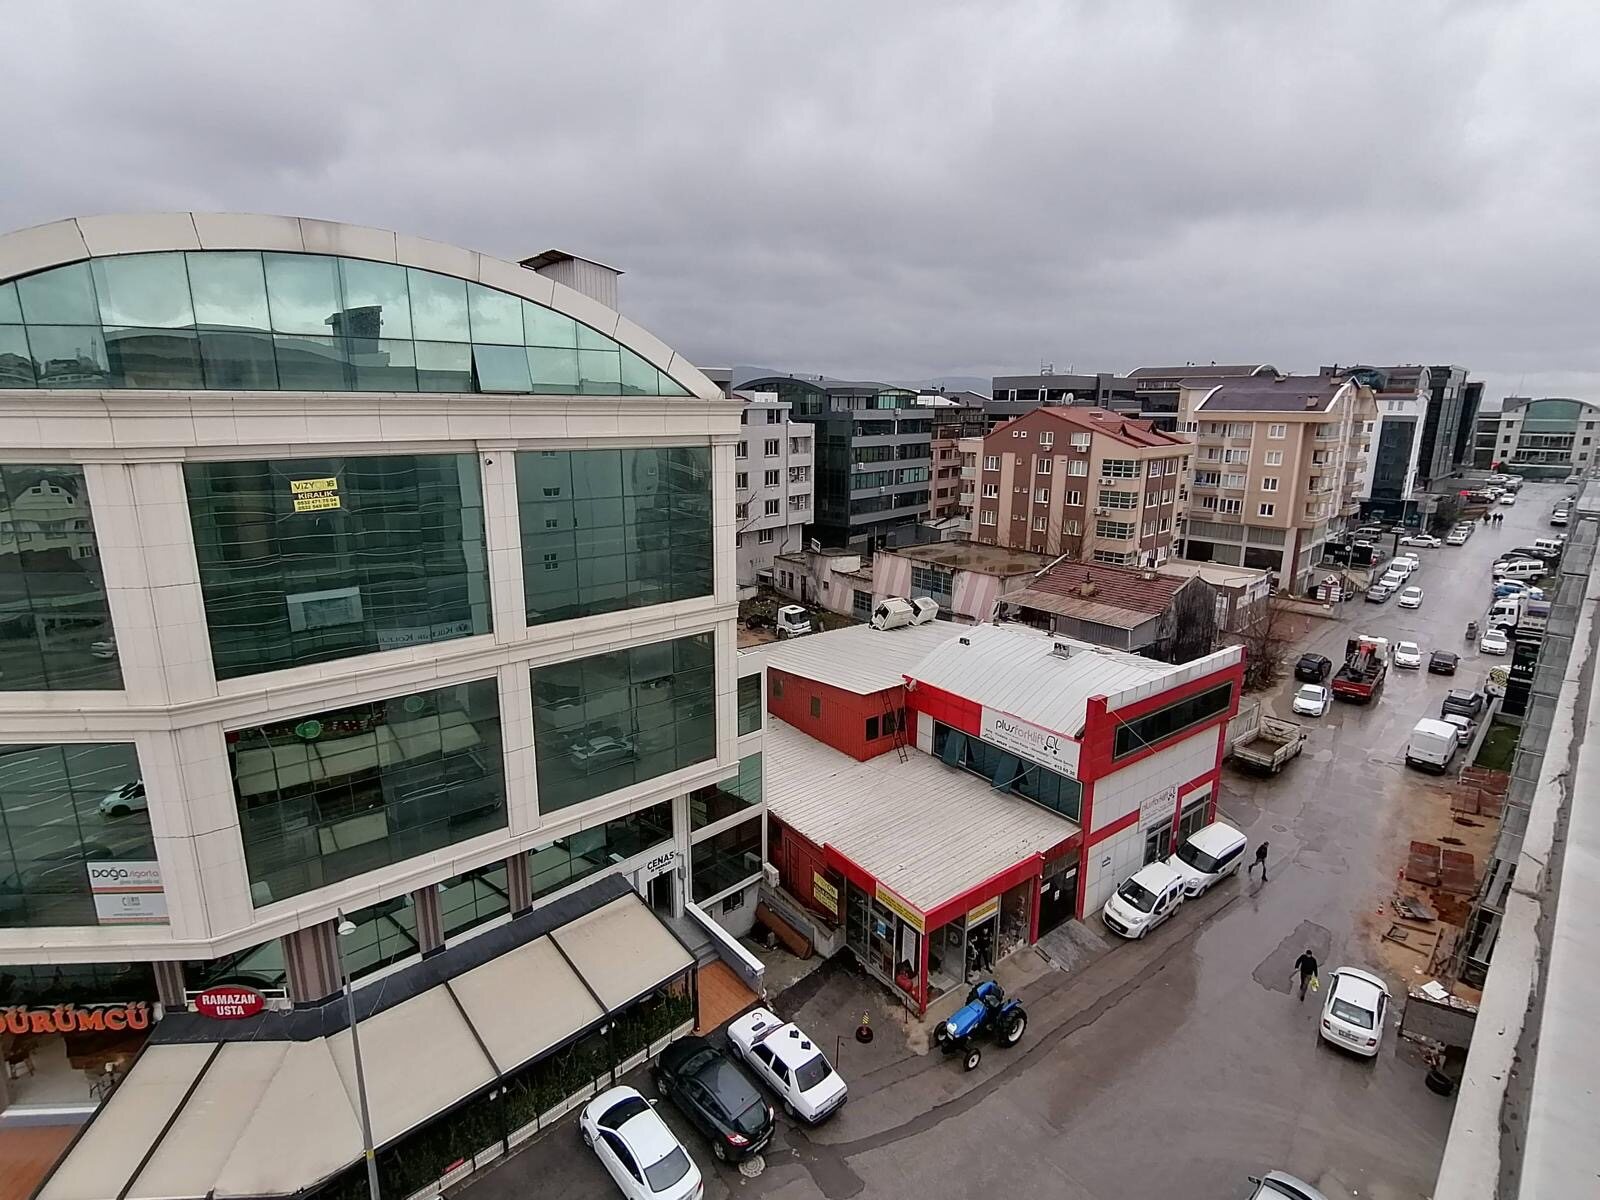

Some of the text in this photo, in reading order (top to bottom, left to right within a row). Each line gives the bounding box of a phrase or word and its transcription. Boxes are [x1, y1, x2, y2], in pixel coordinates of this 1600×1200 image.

[647, 851, 675, 870] CENAS
[202, 994, 256, 1006] RAMAZAN
[216, 1005, 245, 1016] USTA
